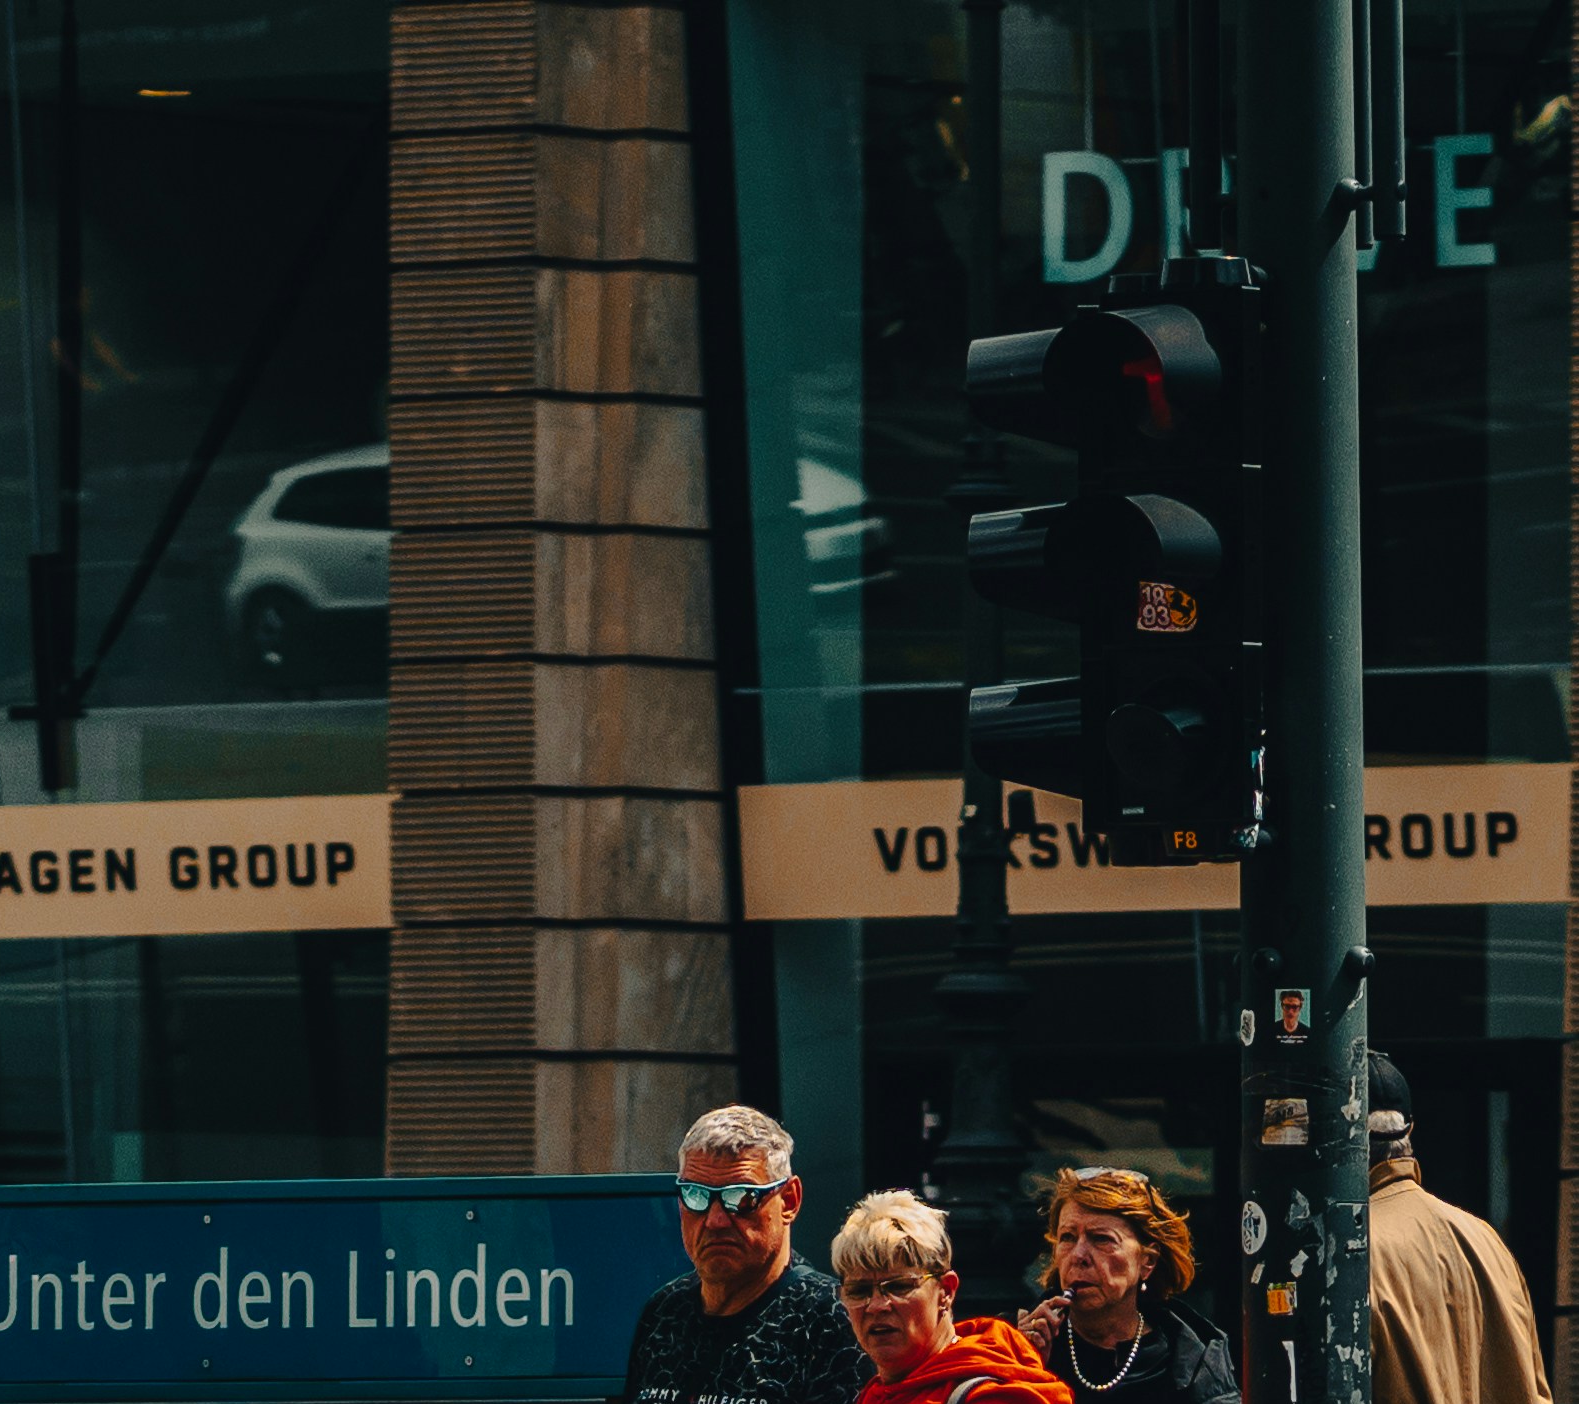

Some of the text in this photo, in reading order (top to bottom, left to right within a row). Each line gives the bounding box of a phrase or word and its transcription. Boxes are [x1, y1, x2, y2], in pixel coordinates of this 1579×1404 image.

[1142, 603, 1171, 627] 93
[1173, 831, 1198, 849] F8
[1364, 812, 1518, 860] ROUP
[169, 842, 356, 891] GROUP
[193, 1246, 315, 1330] den
[348, 1243, 575, 1329] Linden
